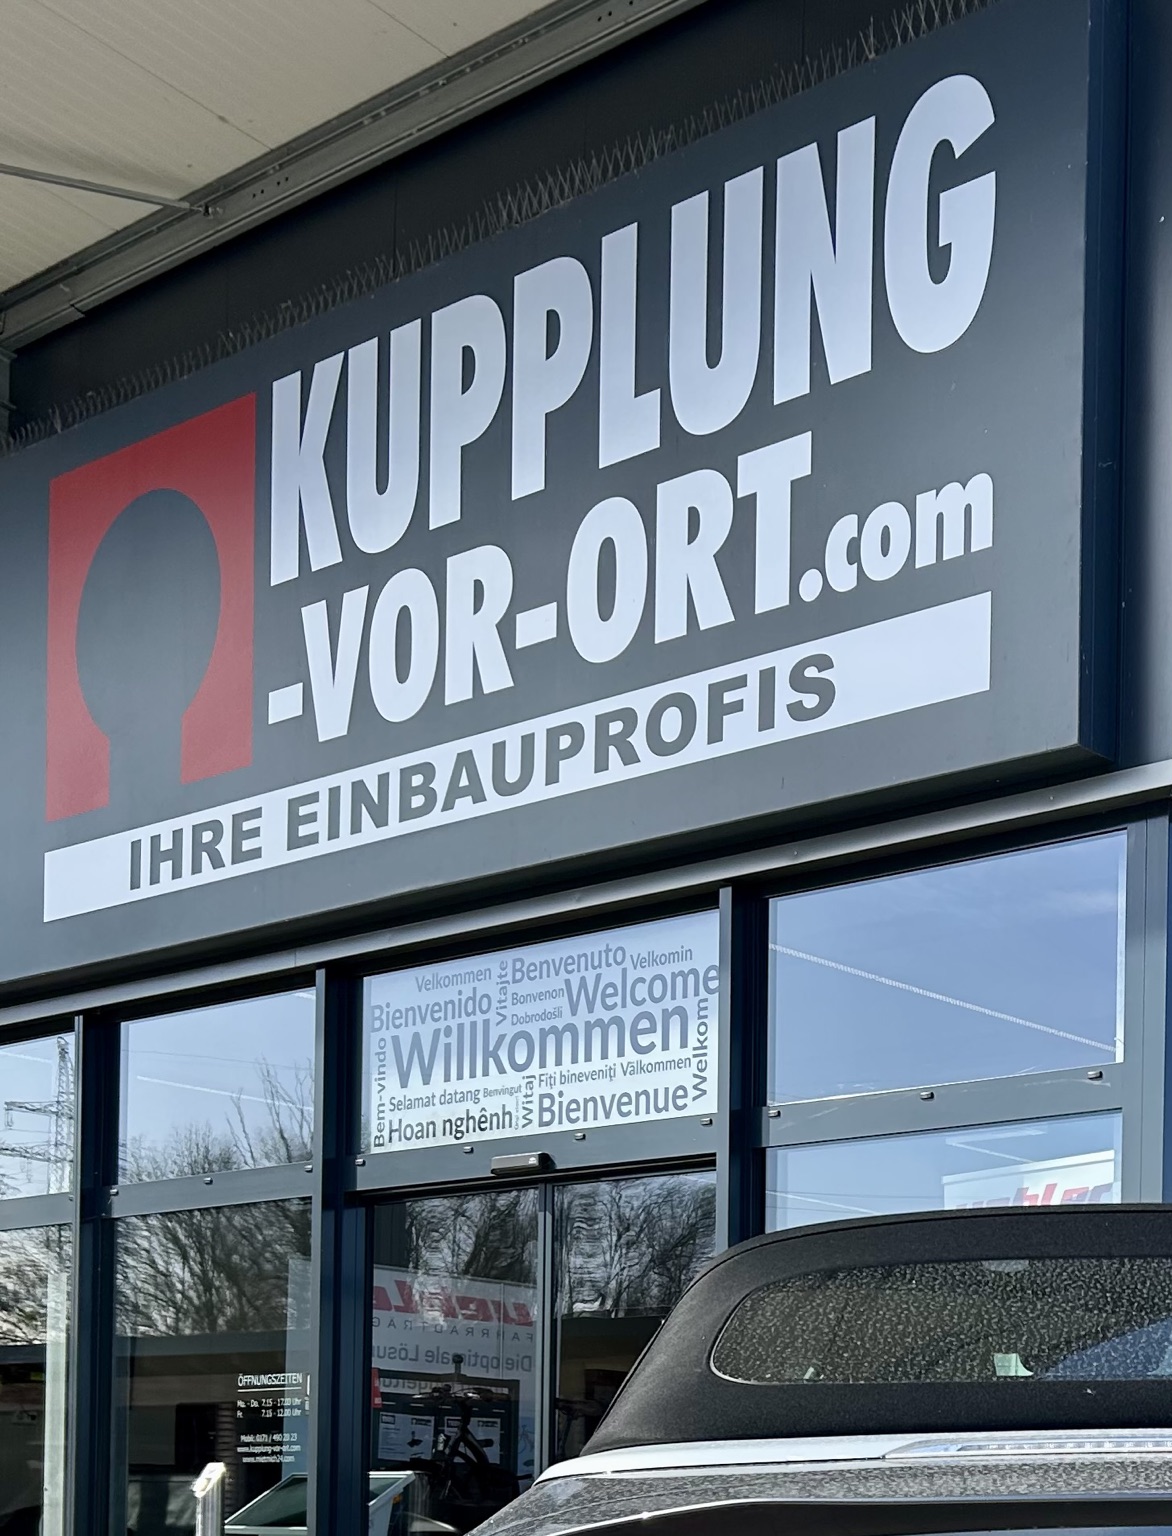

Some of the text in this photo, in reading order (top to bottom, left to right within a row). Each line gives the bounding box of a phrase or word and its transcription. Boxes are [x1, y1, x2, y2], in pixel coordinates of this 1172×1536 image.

[269, 73, 997, 587] KUPPLUNG
[268, 430, 994, 743] -VOR-ORT.com
[127, 653, 837, 892] IHRE EINBAUPROFIS
[415, 967, 492, 993] Velkommen
[511, 943, 626, 985] Benvenuto
[630, 945, 693, 970] Velkomin
[371, 986, 492, 1033] Bienvenido
[495, 960, 511, 1026] Vitajte
[511, 986, 565, 1006] Bonvenon
[564, 964, 720, 1017] Welcome
[511, 1006, 563, 1026] Dobrodošli
[391, 1005, 688, 1088] Willkommen
[692, 997, 709, 1102] Welkom
[374, 1037, 387, 1148] Bem-vindo
[389, 1088, 481, 1112] Selamat datang
[521, 1074, 537, 1129] Witaj
[538, 1084, 688, 1129] Bienvenue
[388, 1103, 513, 1143] Hoan nghênh
[237, 1373, 303, 1387] ÖFFNUNGSZEITEN
